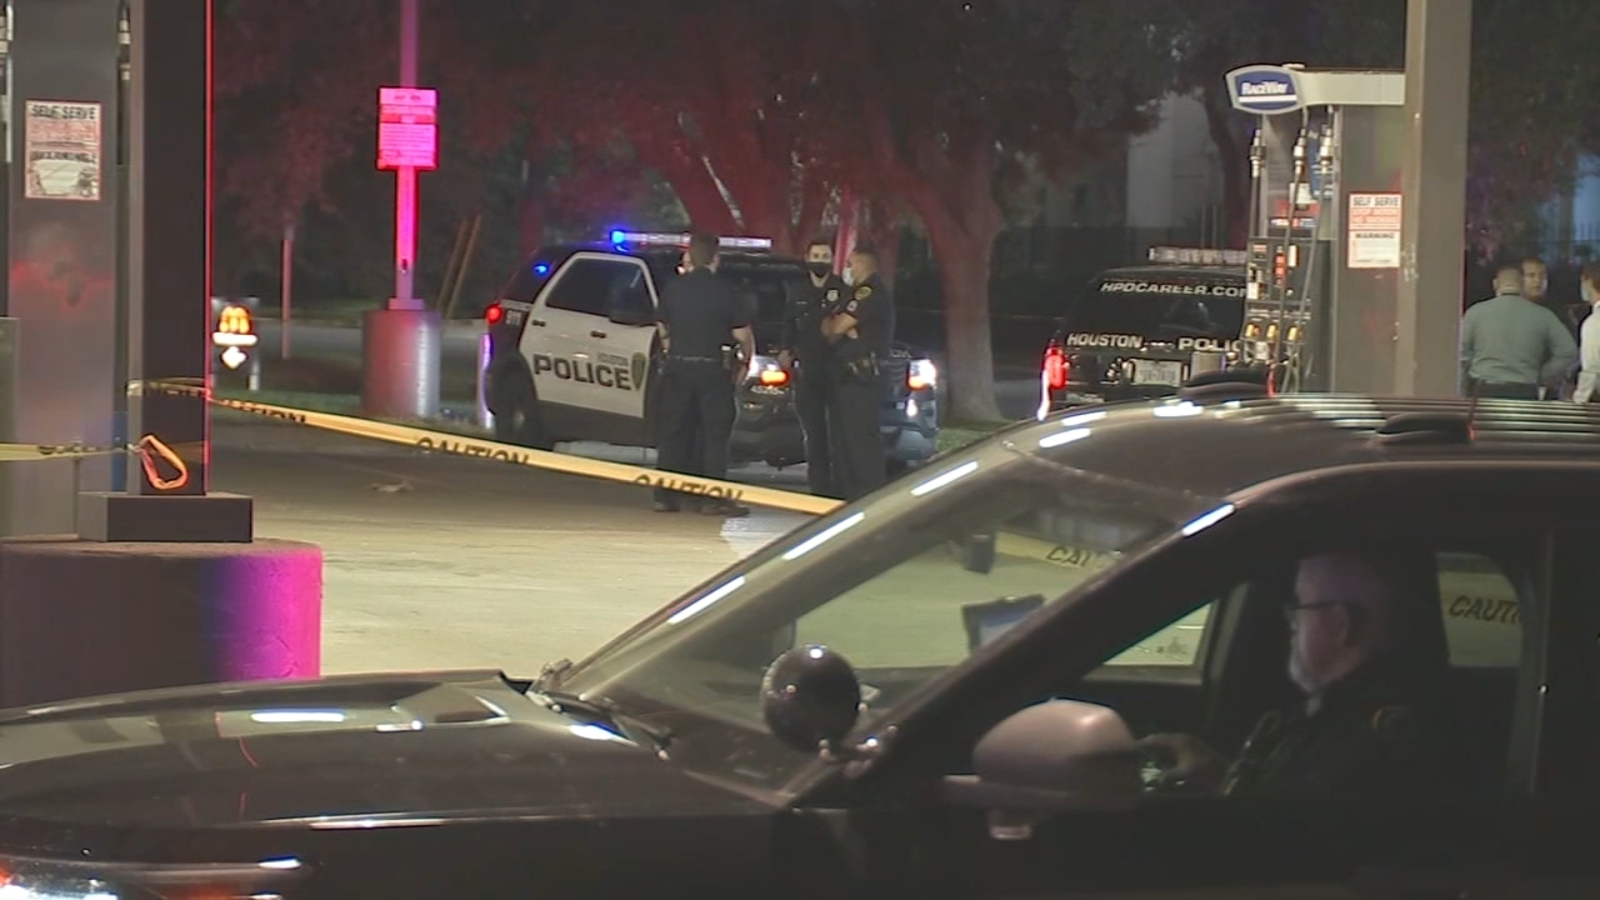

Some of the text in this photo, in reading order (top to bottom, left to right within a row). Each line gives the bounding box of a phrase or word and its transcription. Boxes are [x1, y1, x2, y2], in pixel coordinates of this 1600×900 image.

[30, 104, 97, 120] SELF SERVE
[1353, 196, 1400, 206] SELF SERVE
[1066, 333, 1242, 352] HOUSTON POLIC
[533, 354, 632, 391] POLICE
